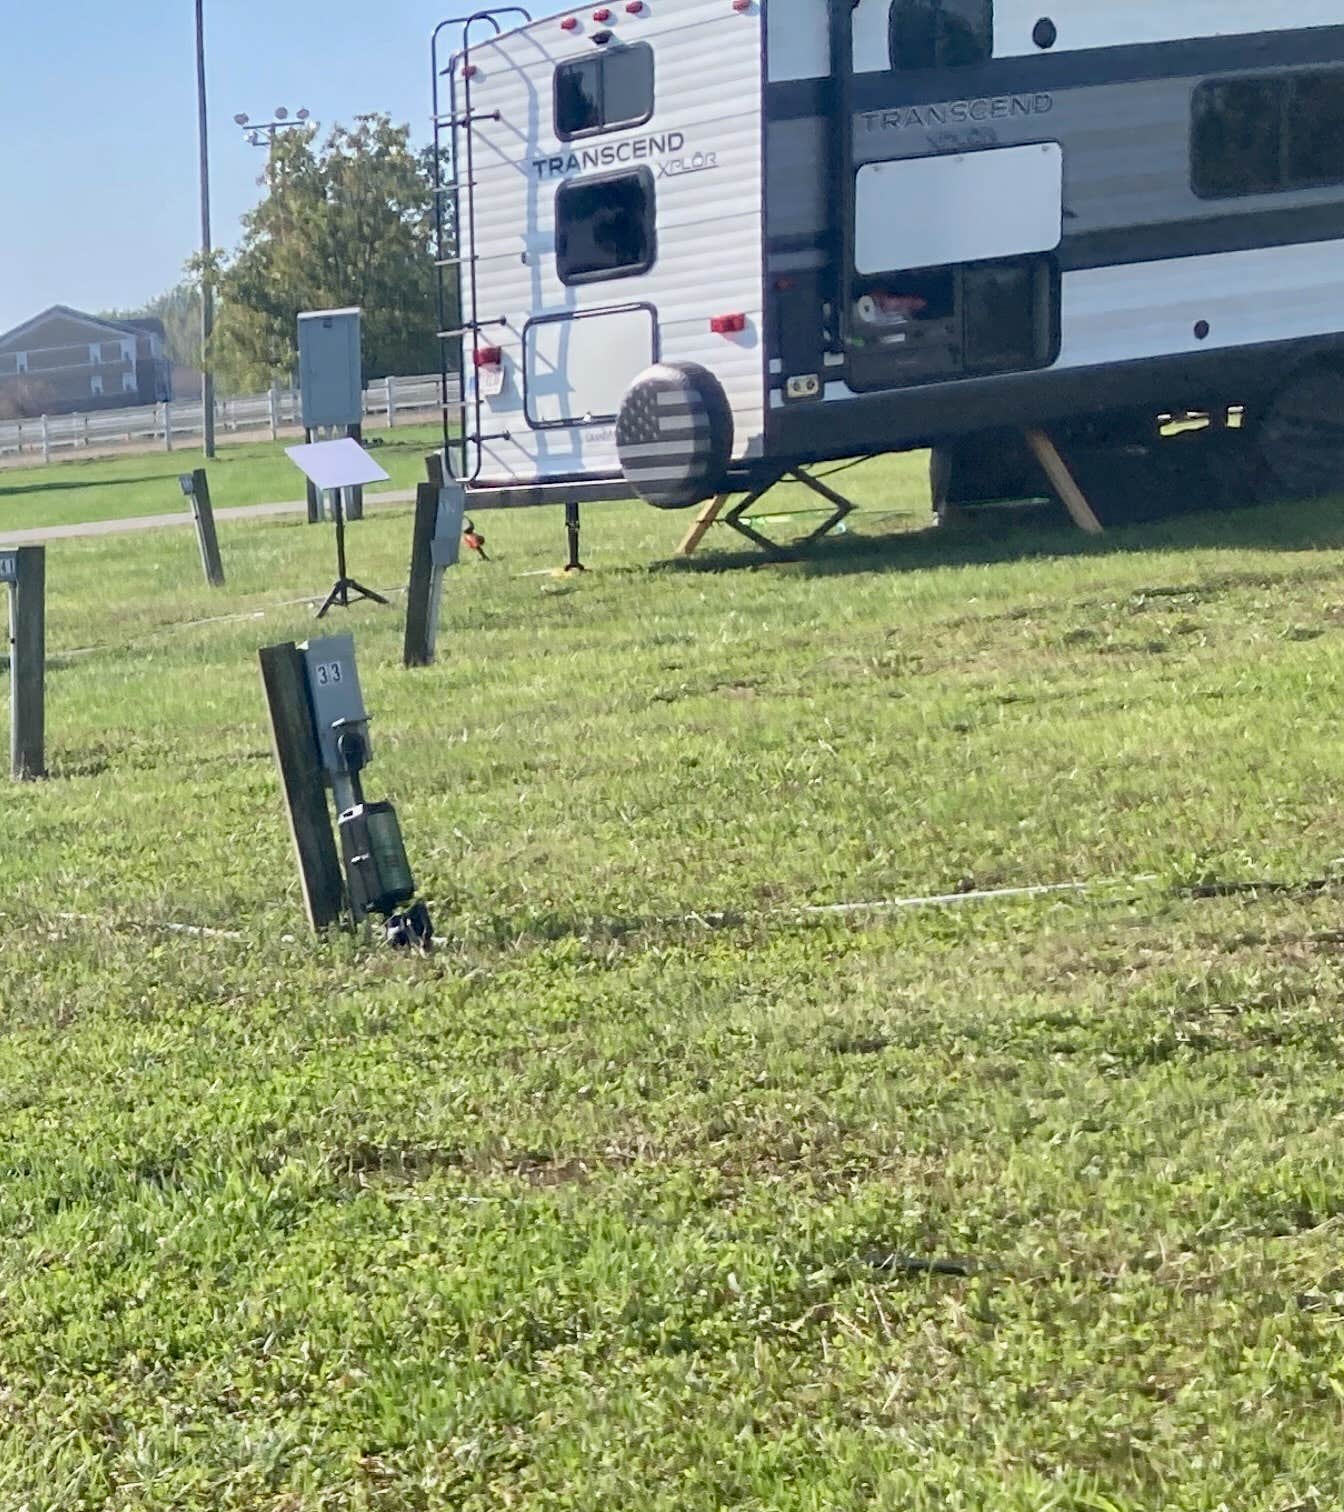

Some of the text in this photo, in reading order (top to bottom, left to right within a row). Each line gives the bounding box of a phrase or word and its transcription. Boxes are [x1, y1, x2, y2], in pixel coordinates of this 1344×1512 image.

[862, 94, 1053, 132] TRANSCEND
[533, 132, 684, 179] TRANSCEND
[317, 663, 341, 684] 33
